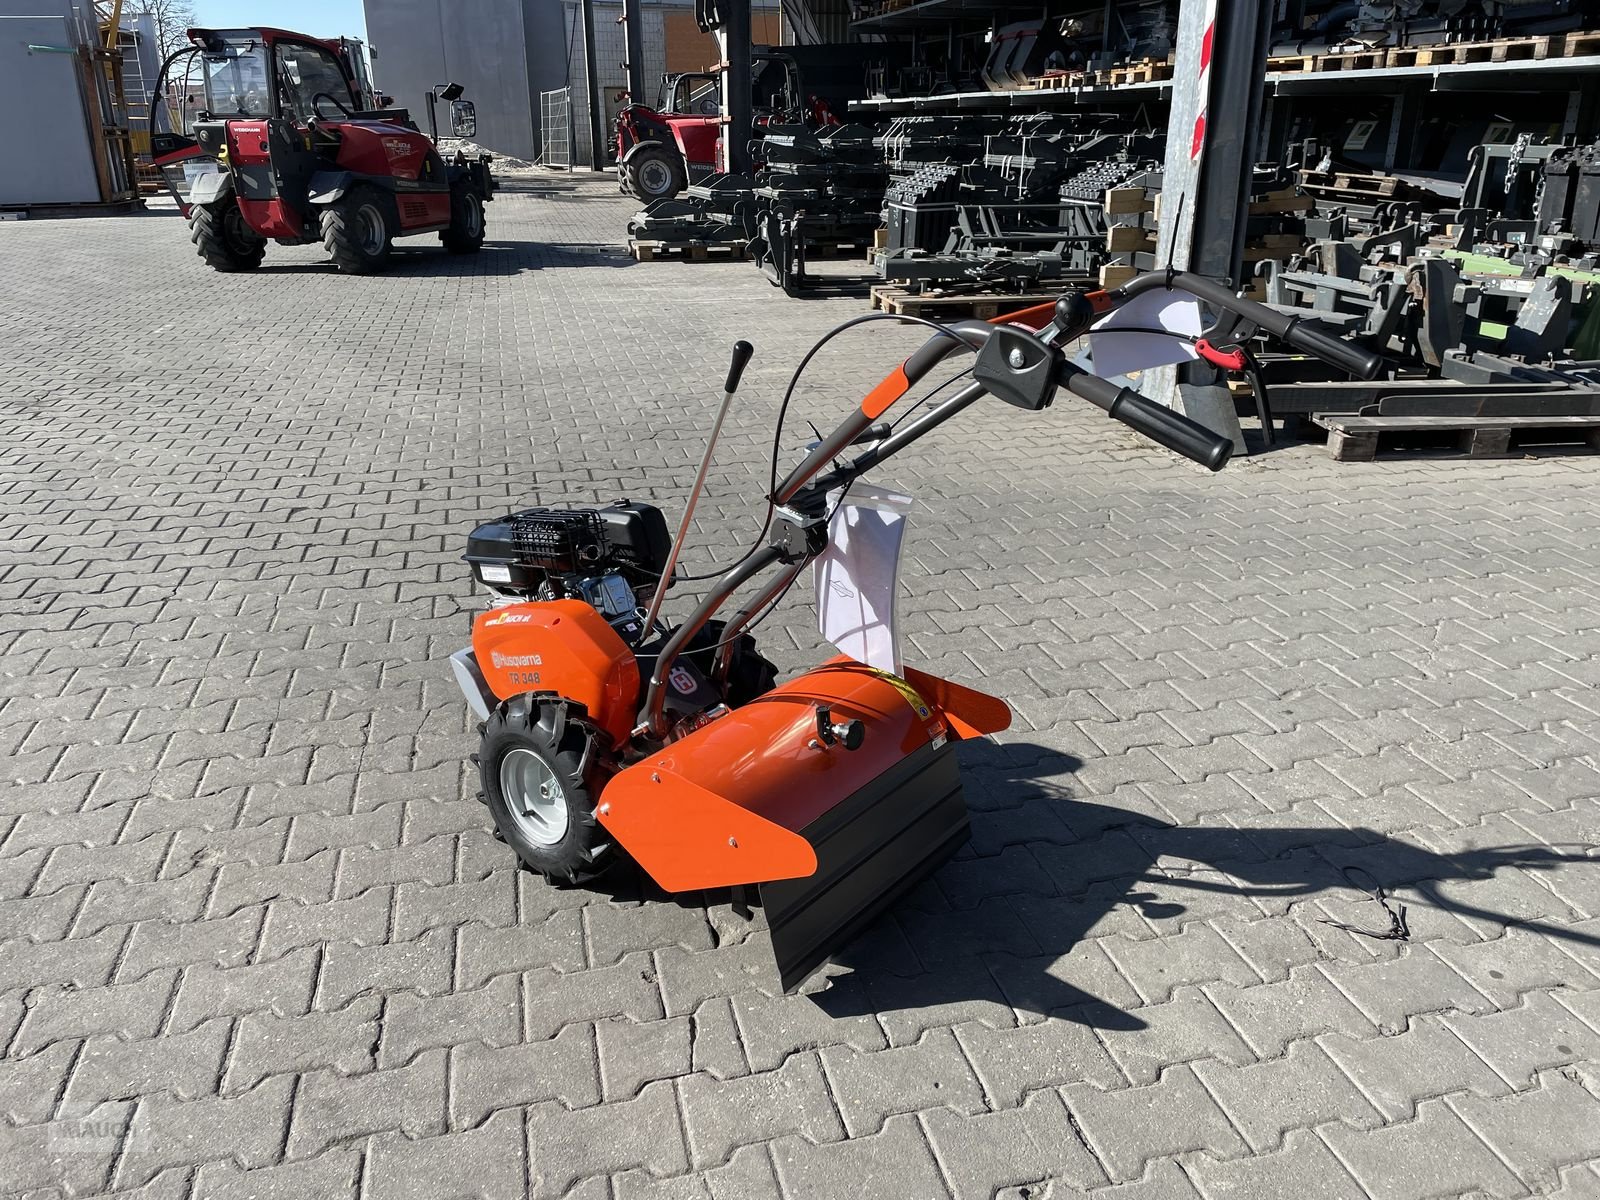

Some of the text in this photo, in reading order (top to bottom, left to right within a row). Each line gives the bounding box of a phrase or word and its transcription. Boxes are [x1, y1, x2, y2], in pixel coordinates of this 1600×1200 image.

[500, 653, 542, 668] Husqvarna
[509, 671, 541, 685] TR 348
